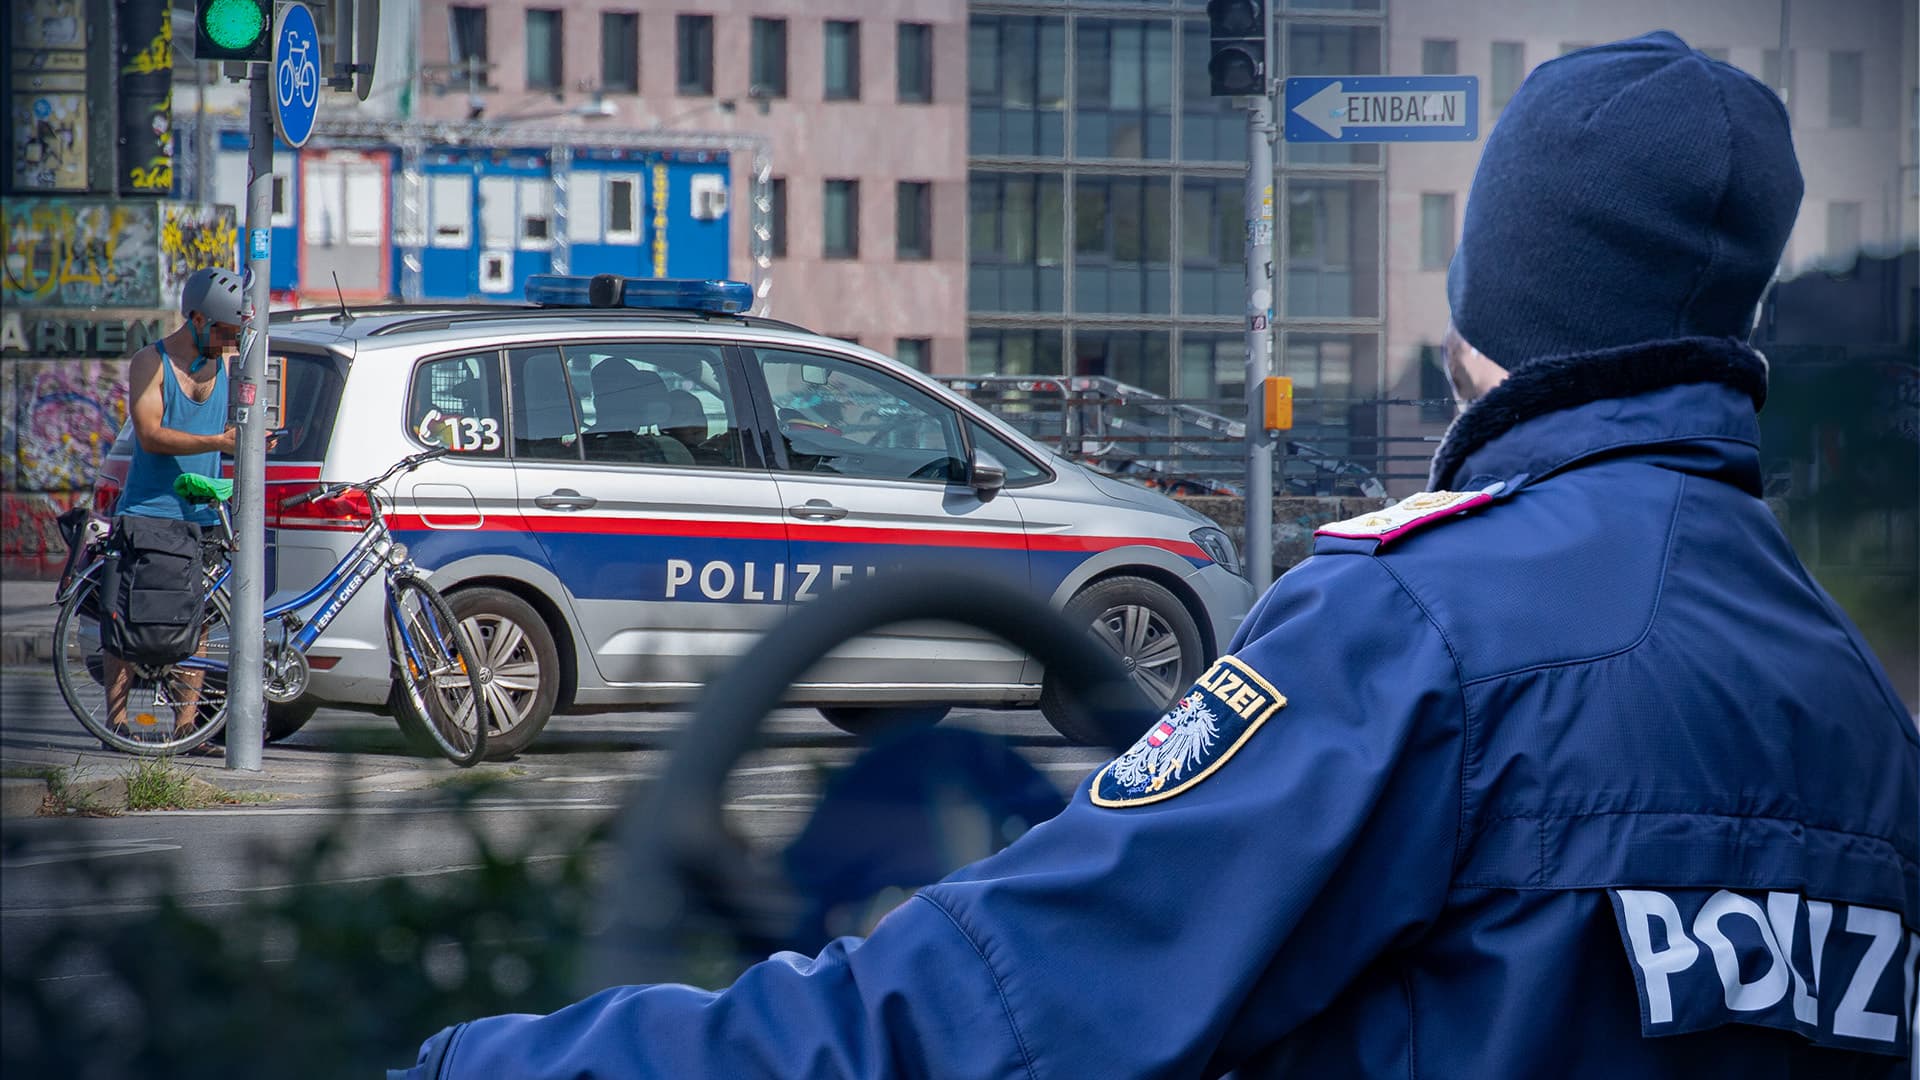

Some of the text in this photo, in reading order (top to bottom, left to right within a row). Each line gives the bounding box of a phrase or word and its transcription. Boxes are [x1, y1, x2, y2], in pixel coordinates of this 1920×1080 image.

[444, 417, 501, 450] 133
[665, 559, 876, 600] POLIZE
[1616, 889, 1919, 1043] POLIZ
